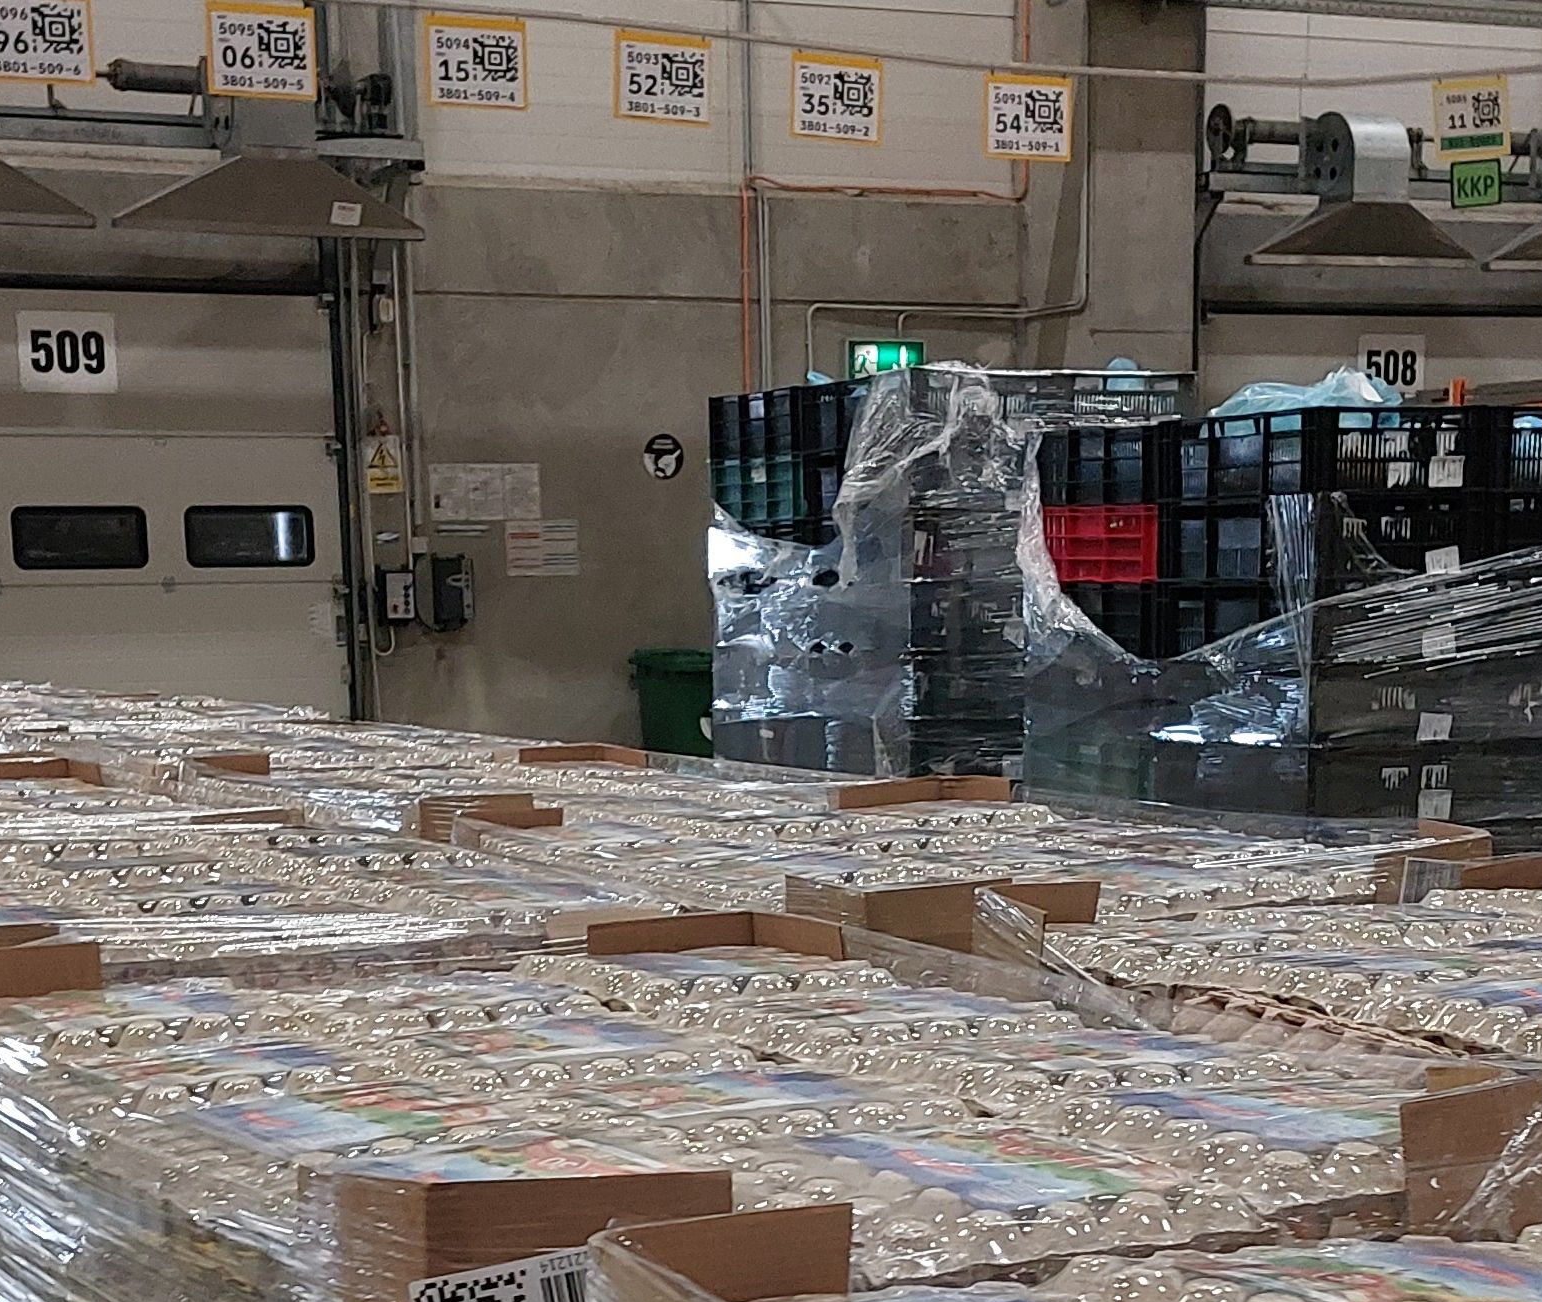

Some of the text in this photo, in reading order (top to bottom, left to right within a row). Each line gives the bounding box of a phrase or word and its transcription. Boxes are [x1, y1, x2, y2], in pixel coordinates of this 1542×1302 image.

[219, 22, 256, 37] 5095
[436, 36, 471, 50] 5094
[222, 45, 255, 69] 06
[627, 50, 660, 66] 5093
[438, 59, 470, 82] 15
[800, 71, 832, 86] 5092
[222, 74, 305, 91] 3B01-509-5
[628, 72, 658, 97] 52
[438, 87, 516, 102] 3B01-509-4
[994, 92, 1023, 106] 5091
[627, 101, 701, 117] 3B01-509-3
[801, 93, 830, 116] 35
[800, 120, 870, 137] 3B01-509-2
[995, 113, 1022, 134] 54
[1448, 113, 1467, 130] 11
[994, 139, 1060, 153] 3B01-509-1
[1457, 174, 1495, 199] KKP
[29, 329, 107, 375] 509
[1365, 348, 1417, 386] 508
[539, 1250, 588, 1273] 21214
